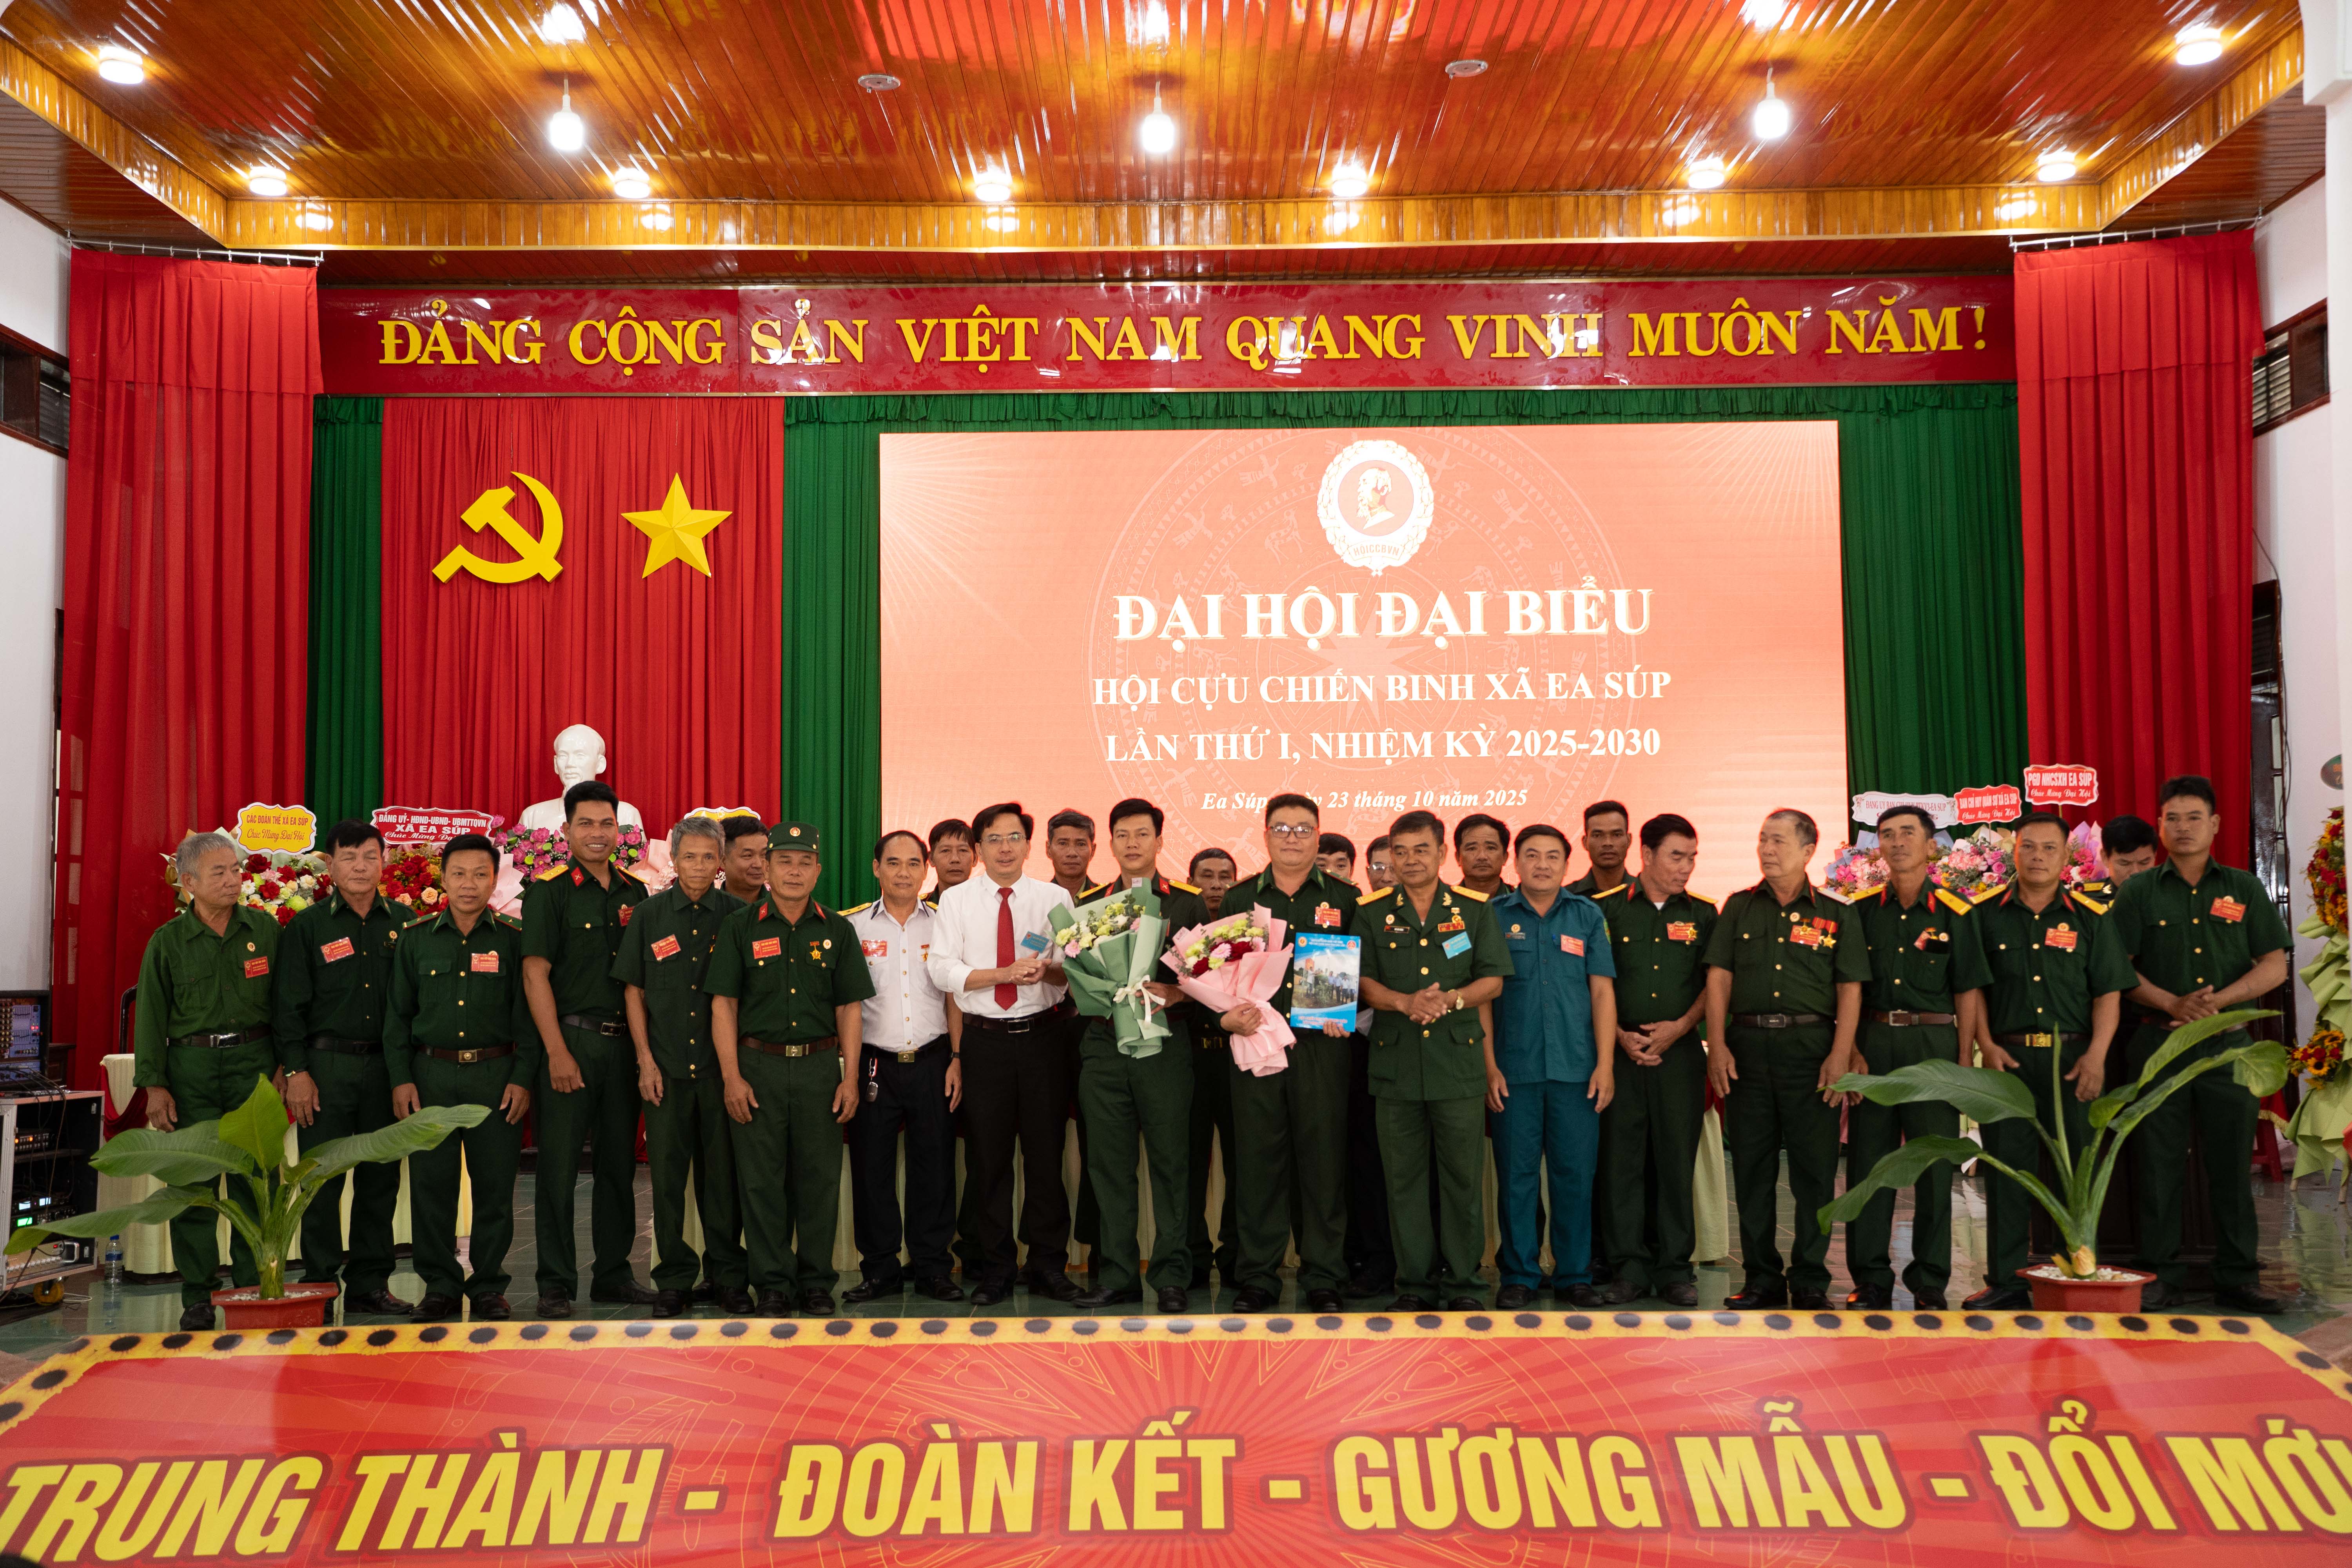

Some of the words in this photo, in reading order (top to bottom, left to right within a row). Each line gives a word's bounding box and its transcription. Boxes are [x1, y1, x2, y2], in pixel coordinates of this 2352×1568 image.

[378, 299, 546, 365] ĐẢNG
[569, 305, 726, 376] CỘNG
[751, 299, 869, 365] SẢN
[896, 304, 1038, 373] VIỆT
[1065, 316, 1202, 361] NAM
[1226, 313, 1425, 370] QUANG
[1446, 313, 1603, 359] VINH
[1628, 297, 1802, 356] MUÔN
[1113, 594, 1226, 653] ĐẠI
[1241, 586, 1359, 651] HỘI
[1375, 591, 1488, 649] ĐẠI
[1503, 575, 1653, 635] BIỂU
[1092, 674, 1161, 711] HỘI
[1171, 672, 1250, 711] CỰU
[1259, 668, 1376, 702] CHIẾN
[1385, 673, 1476, 702] BINH
[1485, 666, 1537, 701] XÃ
[1545, 672, 1595, 699] EA
[1604, 664, 1671, 699] SÚP
[1105, 727, 1180, 761] LẦN
[1189, 726, 1271, 760] THỨ
[1278, 733, 1300, 765] I,
[1309, 727, 1435, 766] NHIỆM
[1444, 723, 1497, 757] KỲ
[1506, 728, 1661, 757] 2025-2030
[2028, 772, 2041, 786] PGD
[2041, 772, 2067, 786] NHCSXH
[2069, 772, 2077, 786] EA
[2078, 770, 2092, 786] SÚP
[1200, 793, 1227, 809] Ea
[1327, 791, 1349, 808] 23
[1354, 790, 1407, 812] tháng
[1411, 790, 1434, 807] 10
[1438, 790, 1478, 807] năm
[1483, 789, 1528, 806] 2025
[1959, 797, 1968, 809] BAN
[2004, 793, 2010, 805] EA
[2031, 788, 2044, 797] Chúc
[2045, 789, 2062, 798] Mừng
[2063, 789, 2076, 798] Đại
[2078, 789, 2091, 798] Hội
[247, 813, 256, 823] CÁC
[258, 814, 271, 824] ĐOÀN
[272, 813, 282, 825] THỂ
[282, 815, 289, 825] XÃ
[290, 817, 296, 825] EA
[298, 816, 308, 826] SÚP
[379, 812, 397, 823] ĐẢNG
[452, 817, 486, 828] UBMTTQVN
[1992, 809, 2003, 818] Đại
[2005, 808, 2015, 817] Hội
[247, 828, 260, 838] Chúc
[262, 829, 279, 842] Mừng
[280, 830, 293, 842] Đại
[293, 830, 305, 842] Hội
[395, 823, 415, 832] XÃ
[419, 825, 437, 833] EA
[442, 826, 471, 835] SÚP
[0, 1456, 323, 1562] TRUNG
[336, 1432, 664, 1551] THÀNH
[684, 1491, 719, 1510] -
[774, 1424, 1038, 1537] ĐOÀN
[1068, 1411, 1236, 1531] KẾT
[1269, 1480, 1301, 1499] -
[1334, 1428, 1661, 1530] GƯƠNG
[1674, 1401, 1906, 1529] MẪU
[1931, 1478, 1969, 1497] -
[1978, 1399, 2178, 1531] ĐỔI
